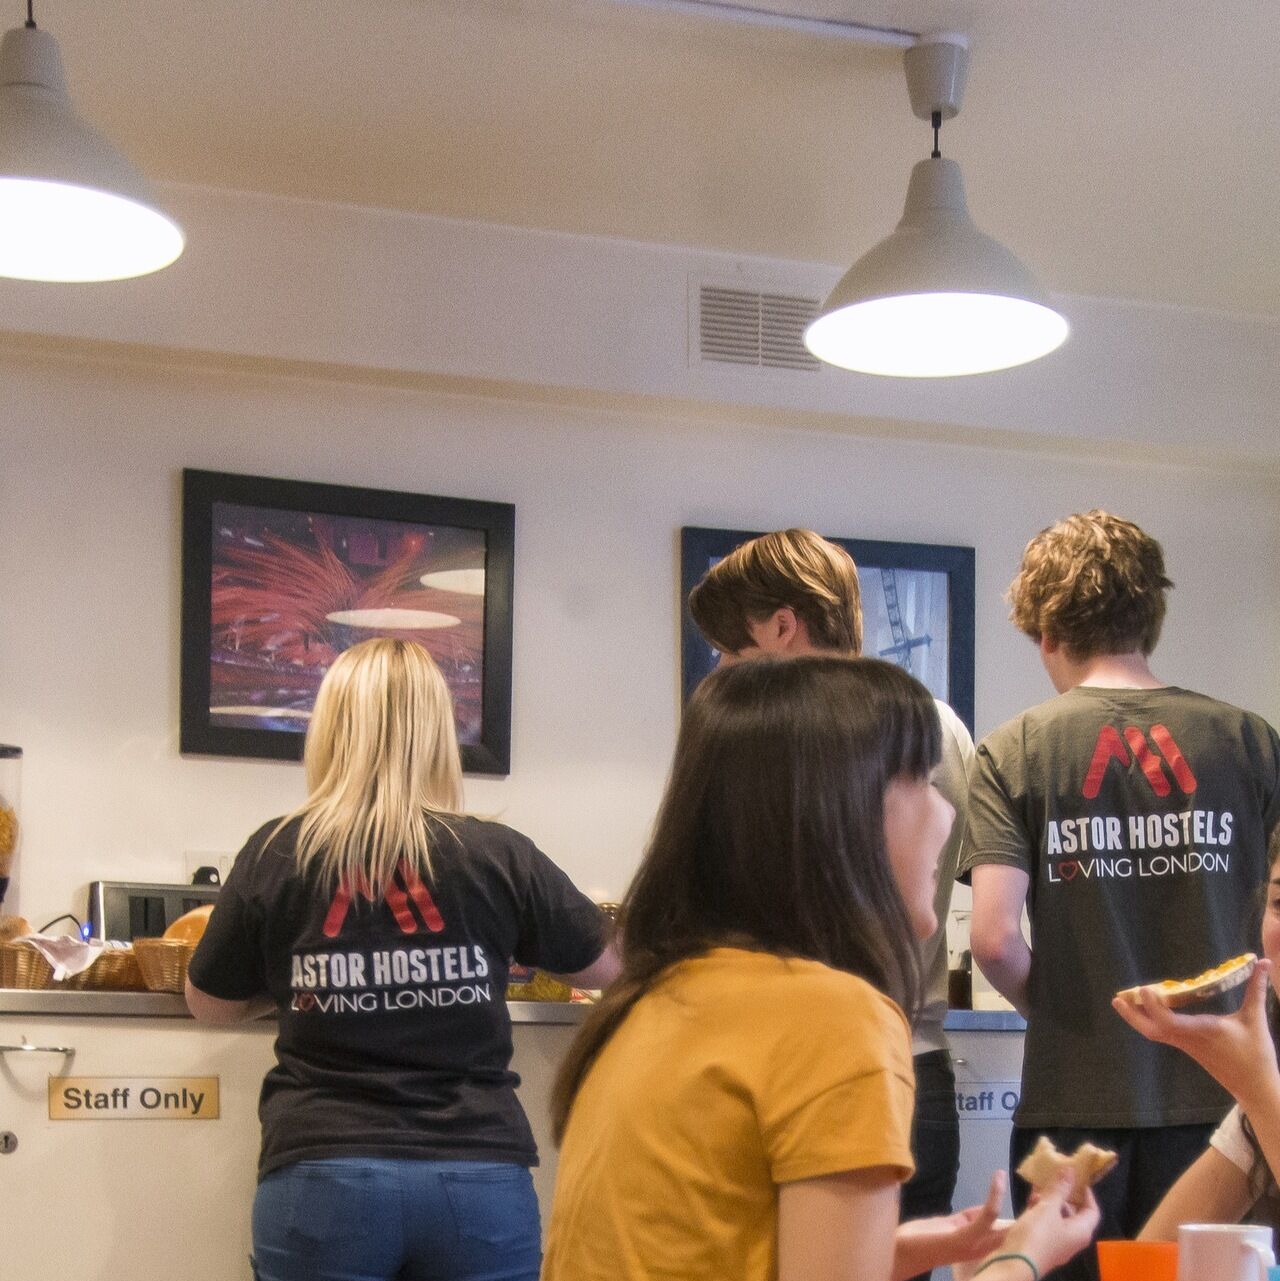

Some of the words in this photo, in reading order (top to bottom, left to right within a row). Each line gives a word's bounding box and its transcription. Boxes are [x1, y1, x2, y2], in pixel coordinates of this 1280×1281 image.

[1047, 816, 1122, 854] ASTOR
[1128, 810, 1233, 850] HOSTELS
[1139, 852, 1229, 877] LONDON
[291, 954, 366, 987] ASTOR
[373, 945, 488, 985] HOSTELS
[384, 984, 491, 1010] LONDON
[63, 1087, 130, 1110] Staff
[139, 1087, 204, 1114] Only
[957, 1091, 993, 1111] taff
